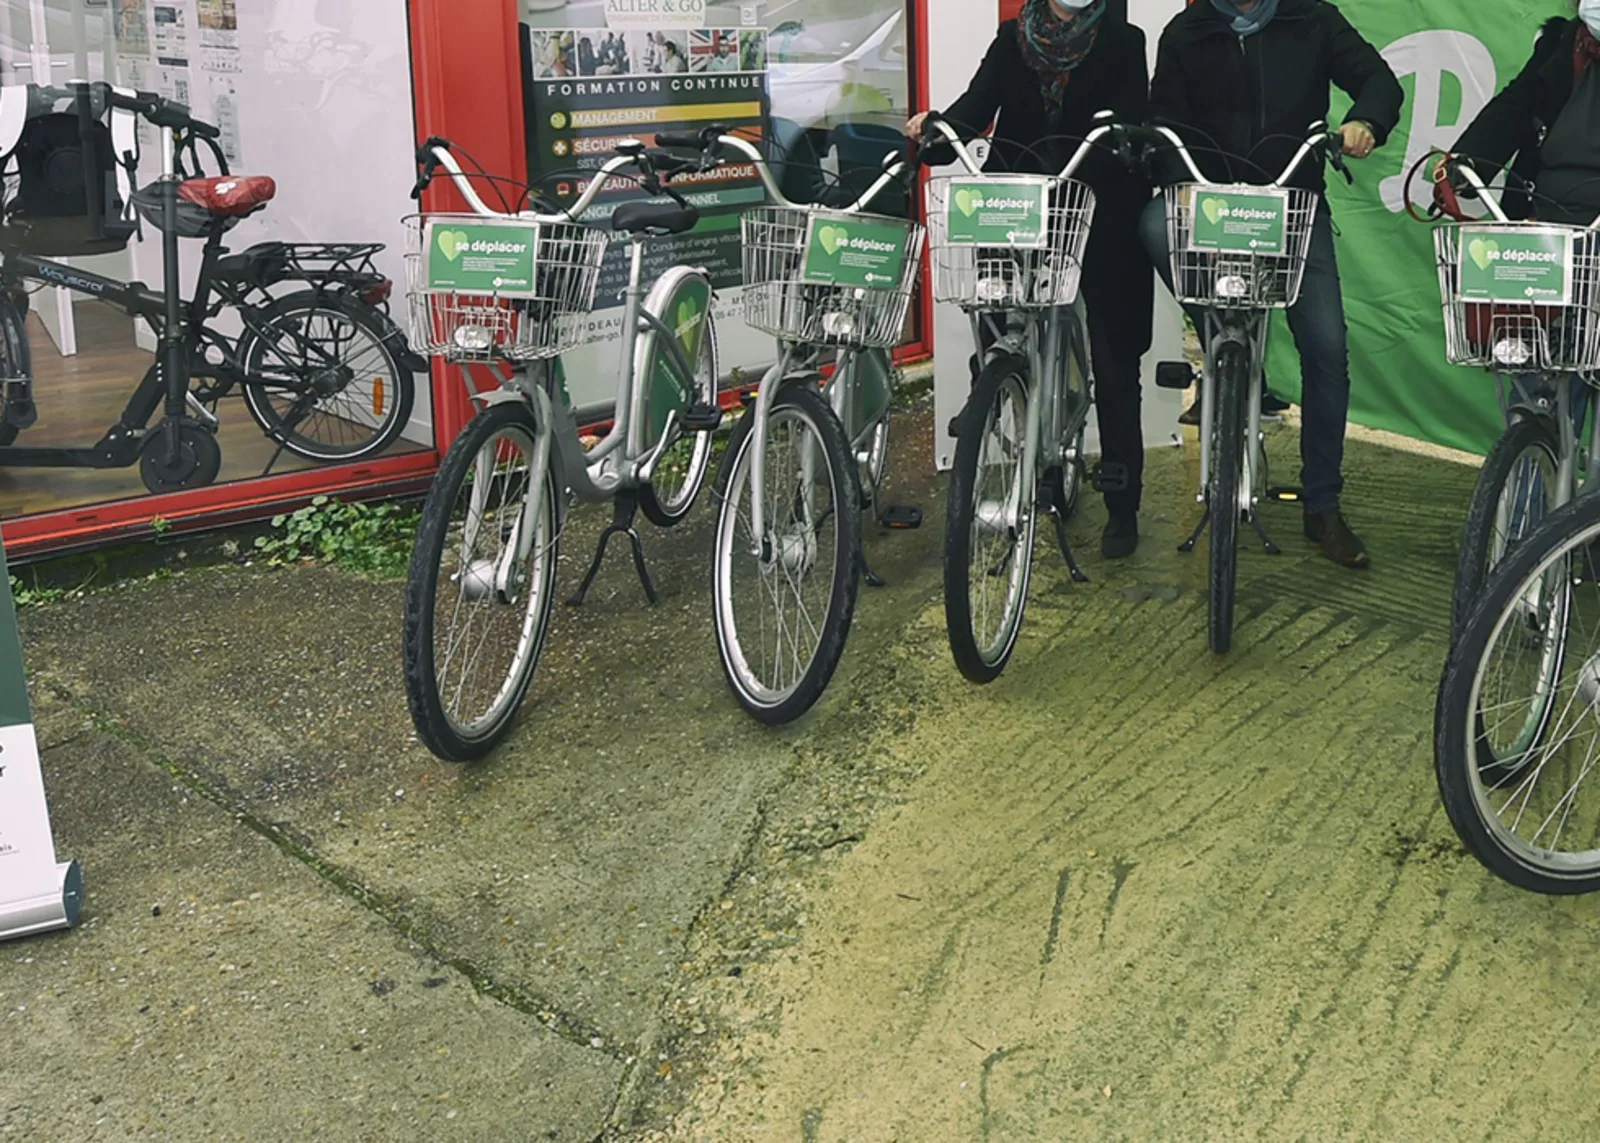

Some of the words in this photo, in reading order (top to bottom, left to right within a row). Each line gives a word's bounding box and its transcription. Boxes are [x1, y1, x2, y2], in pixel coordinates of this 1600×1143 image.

[607, 0, 658, 12] ALTER
[679, 0, 703, 12] GO
[547, 80, 661, 96] FORMATION
[671, 76, 761, 91] CONTINUE
[571, 111, 658, 125] MANAGEMENT
[971, 198, 985, 208] se
[986, 197, 1036, 211] déplacer
[1217, 207, 1230, 217] se
[1231, 207, 1278, 220] déplacer
[455, 241, 470, 252] se
[471, 240, 527, 255] déplacer
[835, 237, 849, 246] se
[850, 237, 897, 252] déplacer
[1486, 250, 1500, 260] se
[1502, 249, 1557, 263] déplacer
